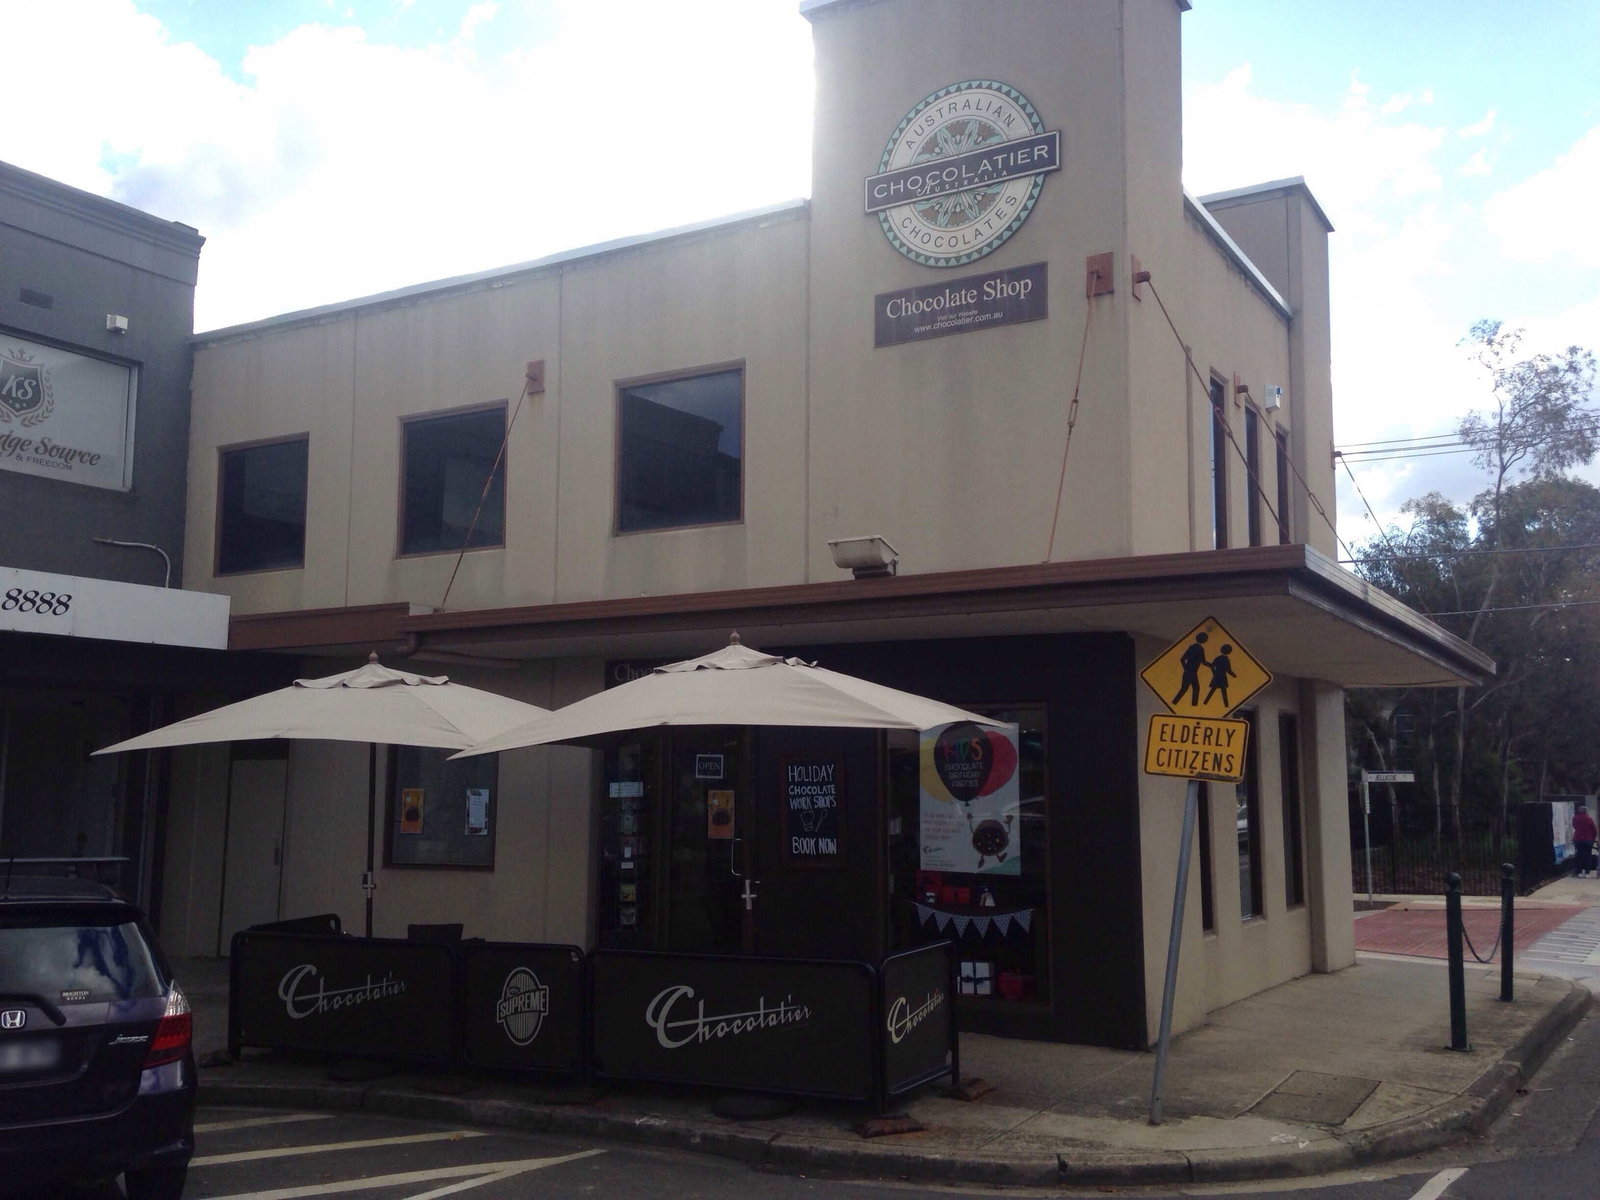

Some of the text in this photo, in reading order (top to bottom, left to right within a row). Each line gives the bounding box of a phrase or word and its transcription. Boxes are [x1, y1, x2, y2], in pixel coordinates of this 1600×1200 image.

[905, 98, 1016, 150] AUSTRALIAN
[873, 144, 1049, 199] CHOCOLATIER
[916, 170, 1008, 197] AUSTRALIA
[901, 194, 1018, 249] CHOCOLATES
[886, 277, 1032, 319] Chocolate Shop
[914, 311, 1004, 333] www.chocolatier.com.au
[1, 374, 37, 400] KS
[15, 453, 73, 472] & FREEDOM
[34, 437, 101, 467] Source
[1, 587, 72, 616] 8888
[1160, 723, 1236, 748] ELDERLY
[698, 760, 721, 771] OPEN
[788, 764, 834, 782] HOLIDAY
[1156, 748, 1234, 773] CITIZENS
[788, 784, 836, 795] CHOCOLATE
[789, 795, 837, 810] WORK SHOPS
[792, 836, 837, 855] BOOK NOW
[278, 964, 408, 1019] Chocolatier
[500, 989, 547, 1018] SUPREME
[645, 985, 813, 1049] Chocolatier
[887, 987, 945, 1044] Chocolatier
